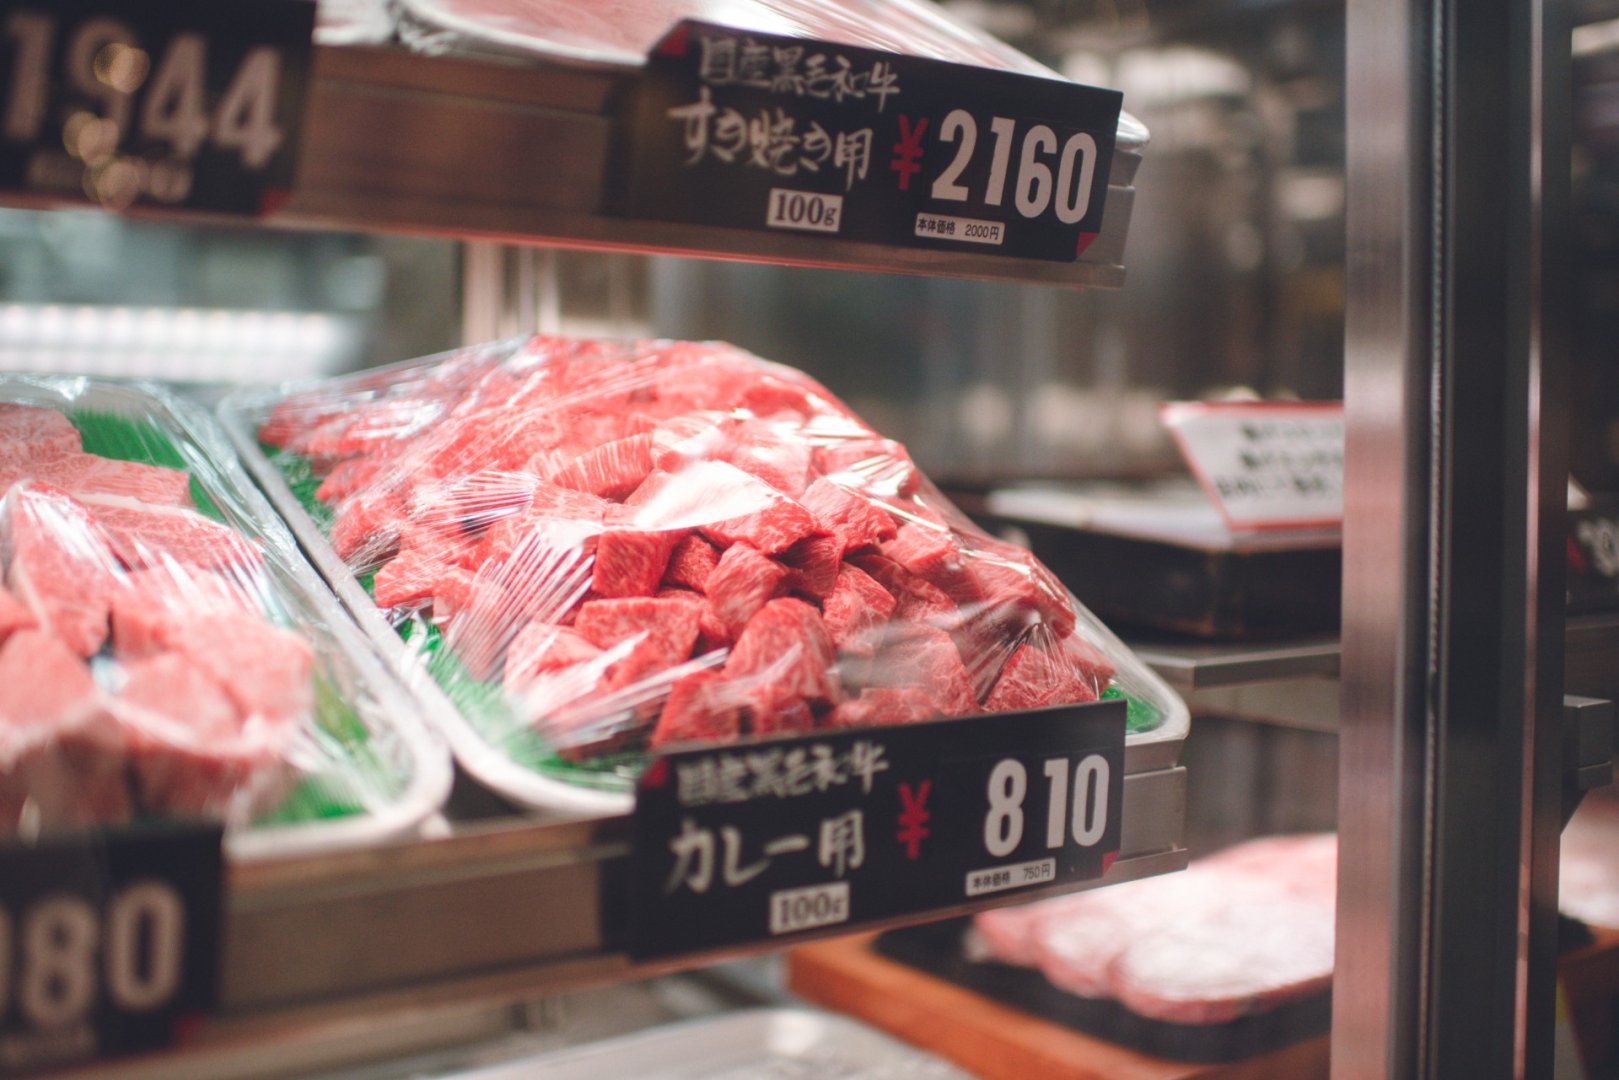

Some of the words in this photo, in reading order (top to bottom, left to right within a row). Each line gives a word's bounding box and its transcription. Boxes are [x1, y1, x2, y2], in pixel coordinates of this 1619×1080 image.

[668, 86, 874, 191] すき焼き用
[775, 192, 837, 226] 100g
[917, 217, 956, 236] 本体価格
[965, 224, 1000, 240] 2000円
[666, 809, 866, 895] カレー用
[1023, 863, 1051, 881] 750円
